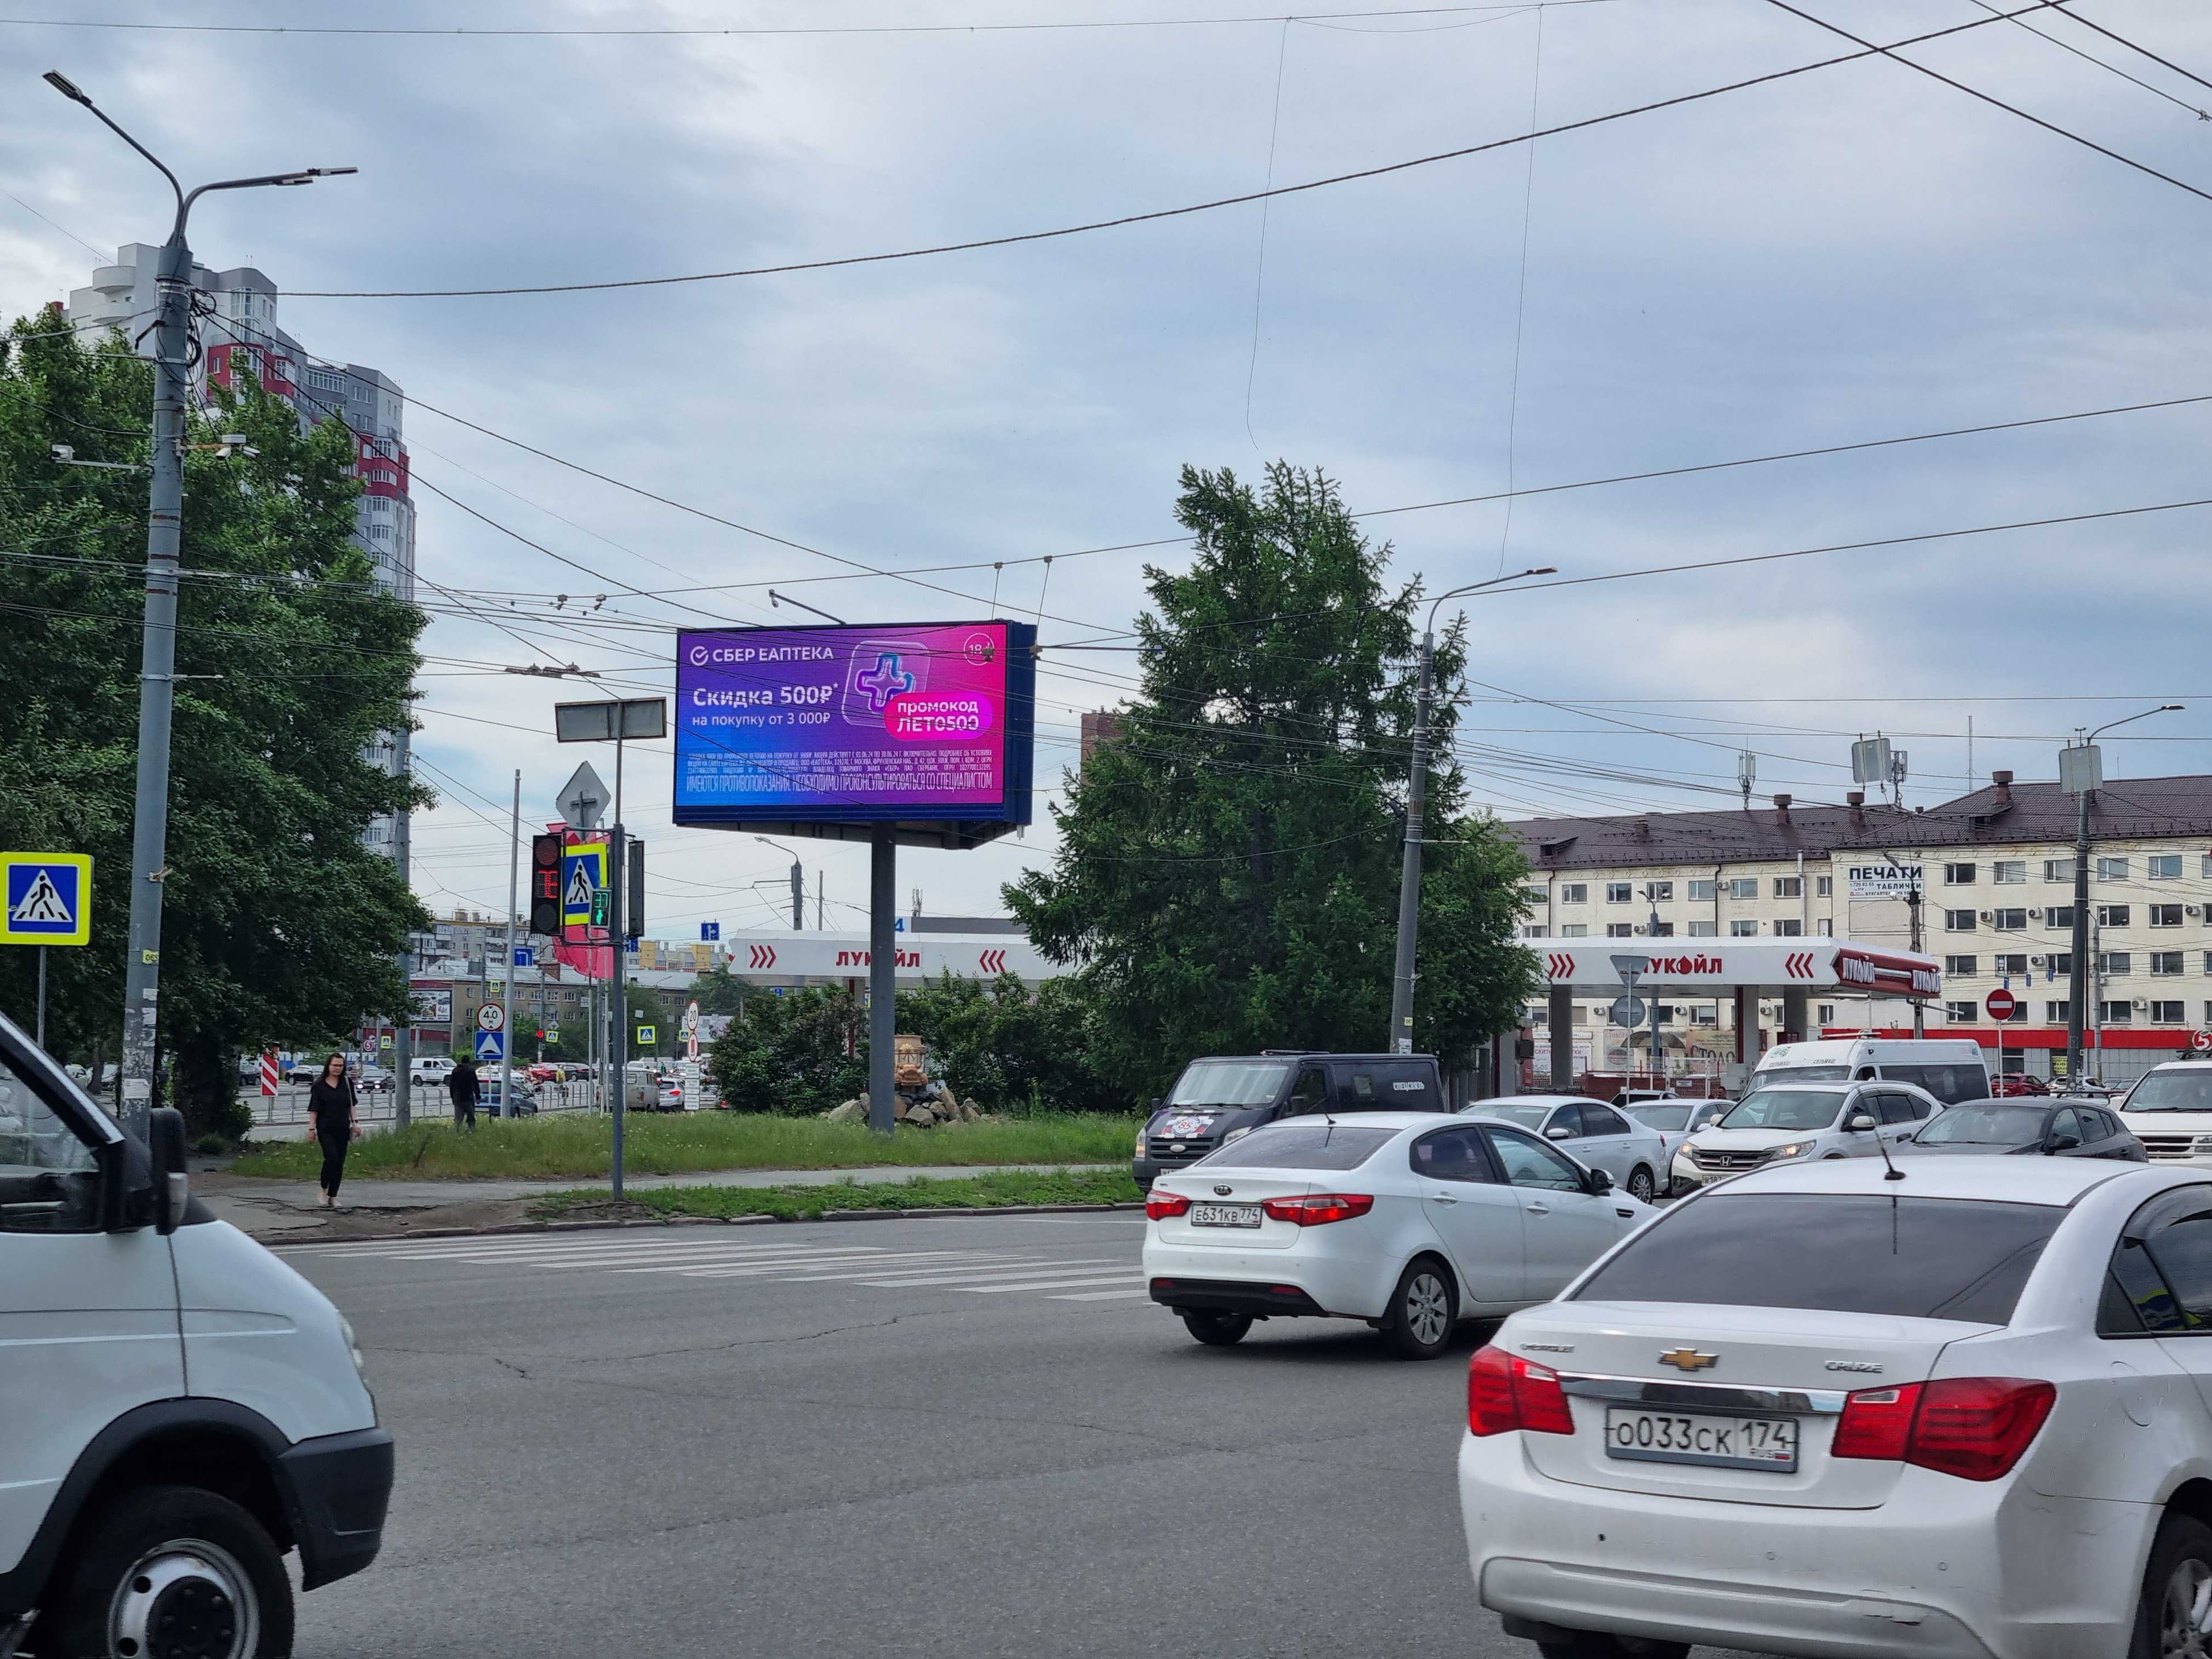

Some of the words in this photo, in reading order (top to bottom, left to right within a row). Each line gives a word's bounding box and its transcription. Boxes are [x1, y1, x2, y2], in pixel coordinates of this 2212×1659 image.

[713, 649, 755, 662] СБЕР
[759, 647, 834, 661] ЕАПТЕКА
[693, 688, 773, 708] Скидка
[897, 701, 979, 716] промокод
[692, 716, 707, 726] на
[711, 715, 765, 728] покупку
[769, 715, 783, 725] от
[787, 713, 794, 724] 3
[897, 715, 979, 732] ЛЕТО500
[828, 750, 851, 759] ДЕЙСТВУЕТ
[687, 775, 718, 793] ИМЕЮТСЯ
[720, 774, 791, 792] ПРОТИВОПОКАЗАНИЯ.
[793, 774, 839, 794] НЕОБХОДИМО
[840, 772, 925, 791] ПРОКОНСУЛЬТИРОВАТЬСЯ
[926, 772, 935, 790] СО
[936, 771, 992, 793] СПЕЦИАЛИСТОМ
[1849, 866, 1922, 880] ПЕЧАТИ
[836, 948, 921, 967] ЛУКЙЛ
[1643, 953, 1722, 975] УКОЙЛ
[690, 1010, 696, 1022] 20
[1393, 1081, 1425, 1092] СПЕЦСВЯЗЬ
[1741, 1421, 1786, 1449] 174
